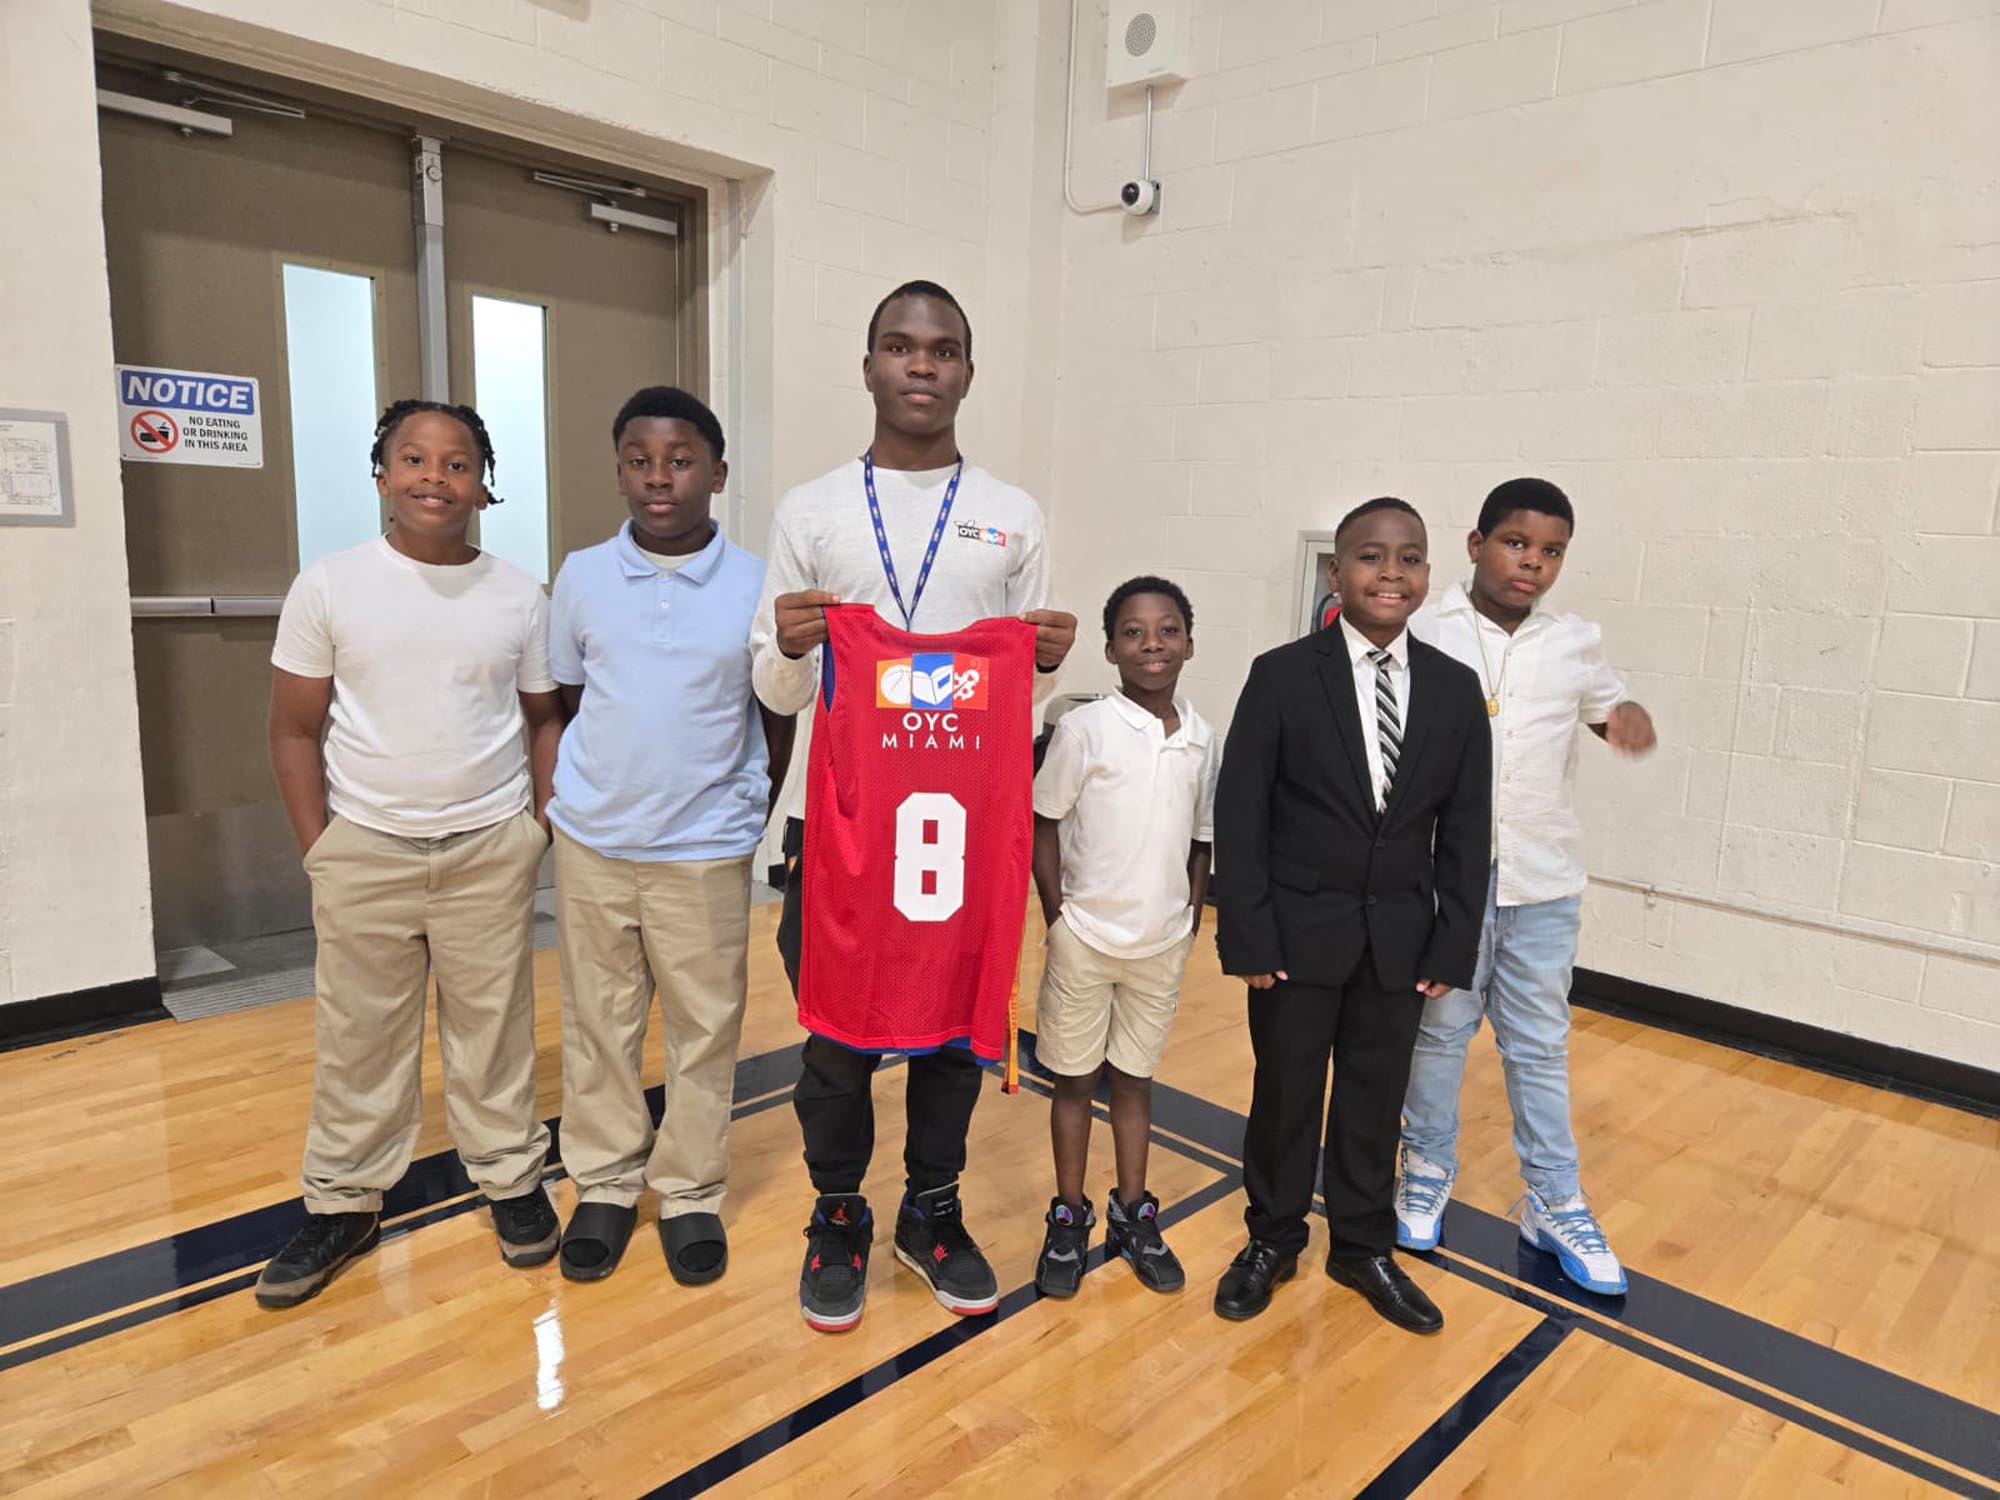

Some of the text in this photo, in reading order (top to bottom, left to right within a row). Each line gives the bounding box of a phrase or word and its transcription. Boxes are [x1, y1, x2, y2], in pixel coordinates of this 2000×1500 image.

[127, 376, 250, 409] NOTICE
[189, 416, 240, 428] NO EATING
[183, 427, 248, 440] OR DRINKING
[185, 439, 248, 452] IN THIS AREA
[959, 527, 979, 538] OYC
[902, 712, 959, 732] OYC
[882, 733, 981, 750] MIAMI
[893, 792, 967, 922] 8
